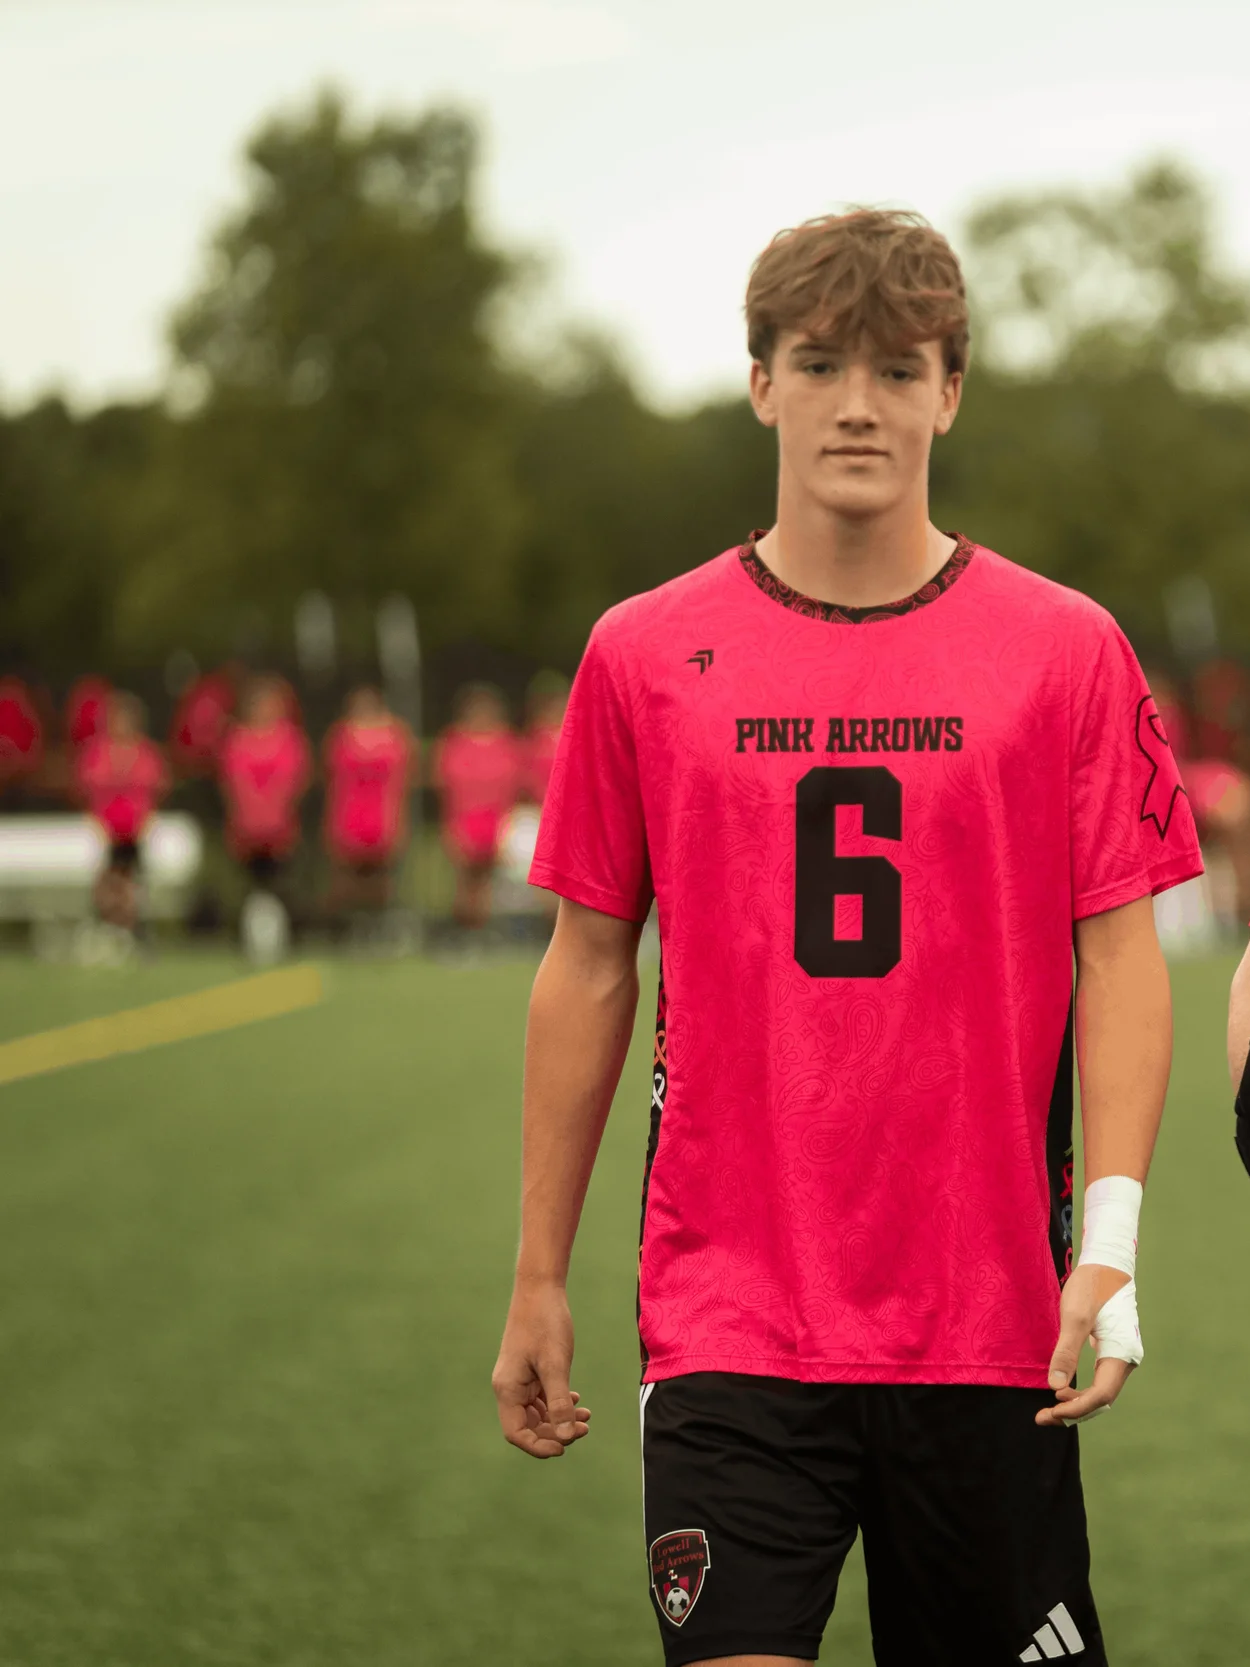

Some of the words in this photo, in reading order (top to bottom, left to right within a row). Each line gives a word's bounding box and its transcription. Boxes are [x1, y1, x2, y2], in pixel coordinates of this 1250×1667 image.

[735, 717, 815, 753] PINK
[824, 716, 964, 753] ARROWS
[794, 766, 903, 979] 6
